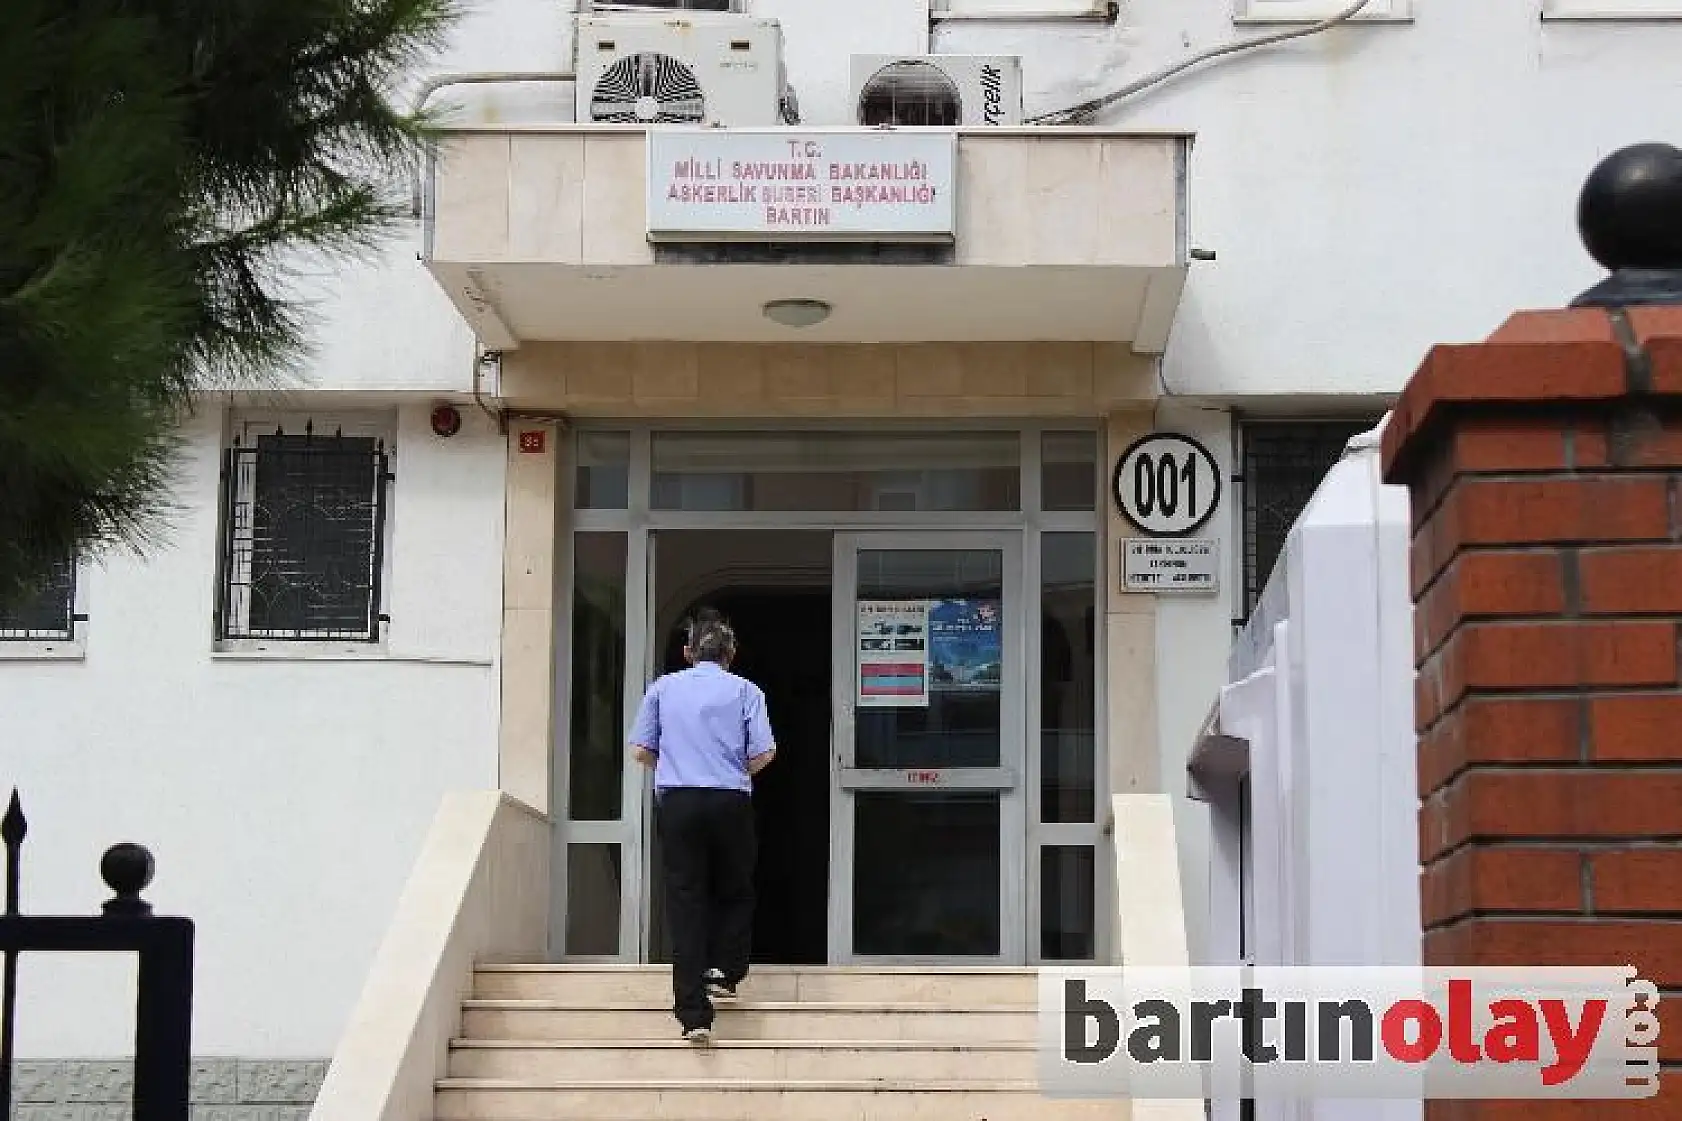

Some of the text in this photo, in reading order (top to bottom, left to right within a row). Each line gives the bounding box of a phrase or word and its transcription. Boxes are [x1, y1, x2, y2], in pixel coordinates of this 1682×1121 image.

[979, 64, 1006, 127] rçelik
[674, 156, 927, 180] MİLLİ SAVUNMA BAKANLIĞI
[667, 182, 757, 203] ASKERLİK
[831, 183, 937, 208] BAŞKANLIĞI
[766, 207, 831, 225] BARTIN
[1134, 452, 1196, 519] 001
